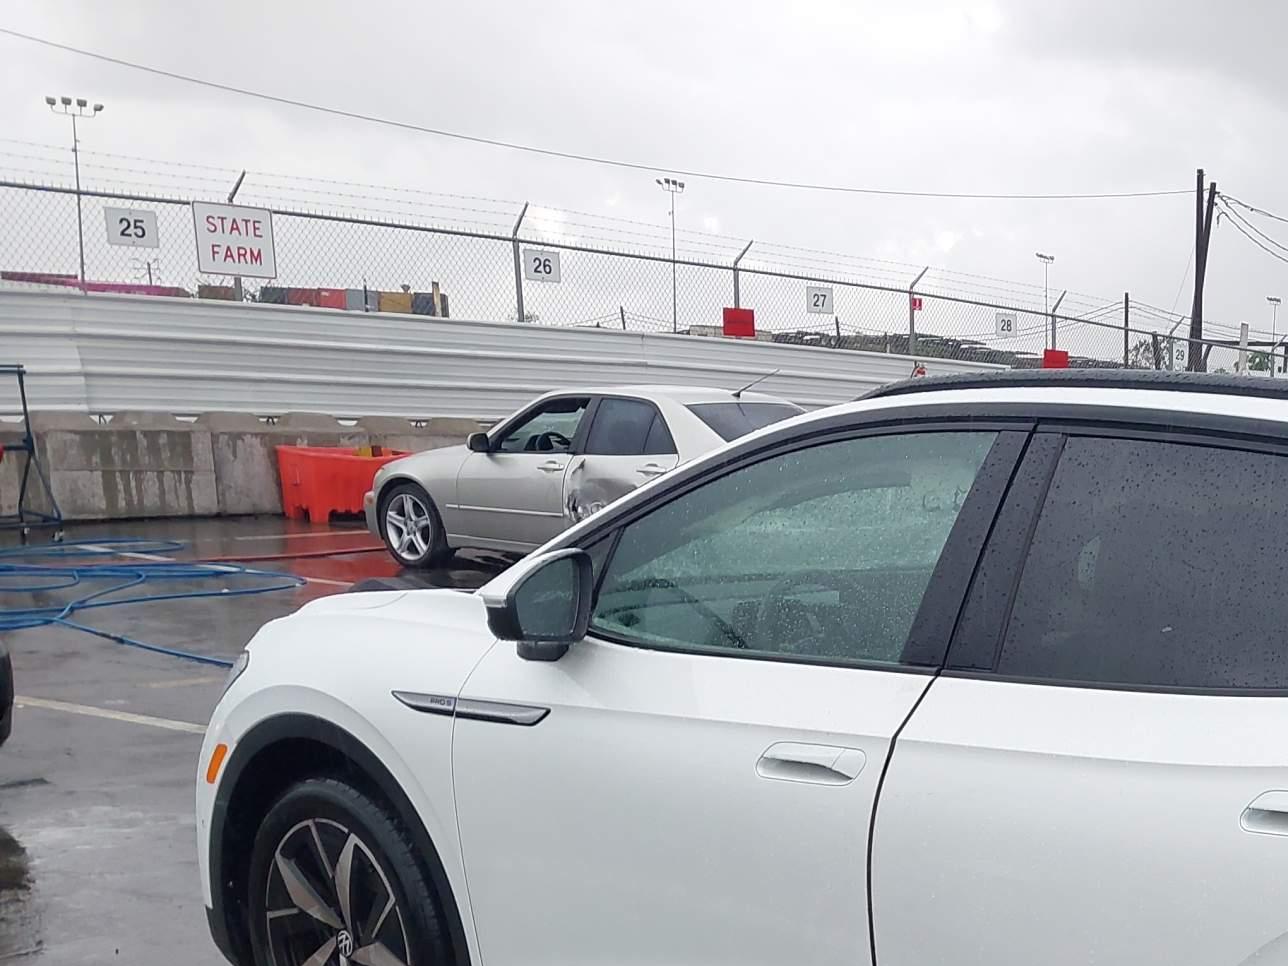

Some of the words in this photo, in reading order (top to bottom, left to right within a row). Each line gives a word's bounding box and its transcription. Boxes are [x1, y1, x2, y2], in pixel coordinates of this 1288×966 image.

[118, 217, 146, 239] 25
[206, 215, 263, 238] STATE
[211, 244, 263, 266] FARM
[533, 257, 552, 275] 26
[812, 293, 827, 308] 27
[1000, 319, 1012, 332] 28
[1175, 349, 1185, 361] 29
